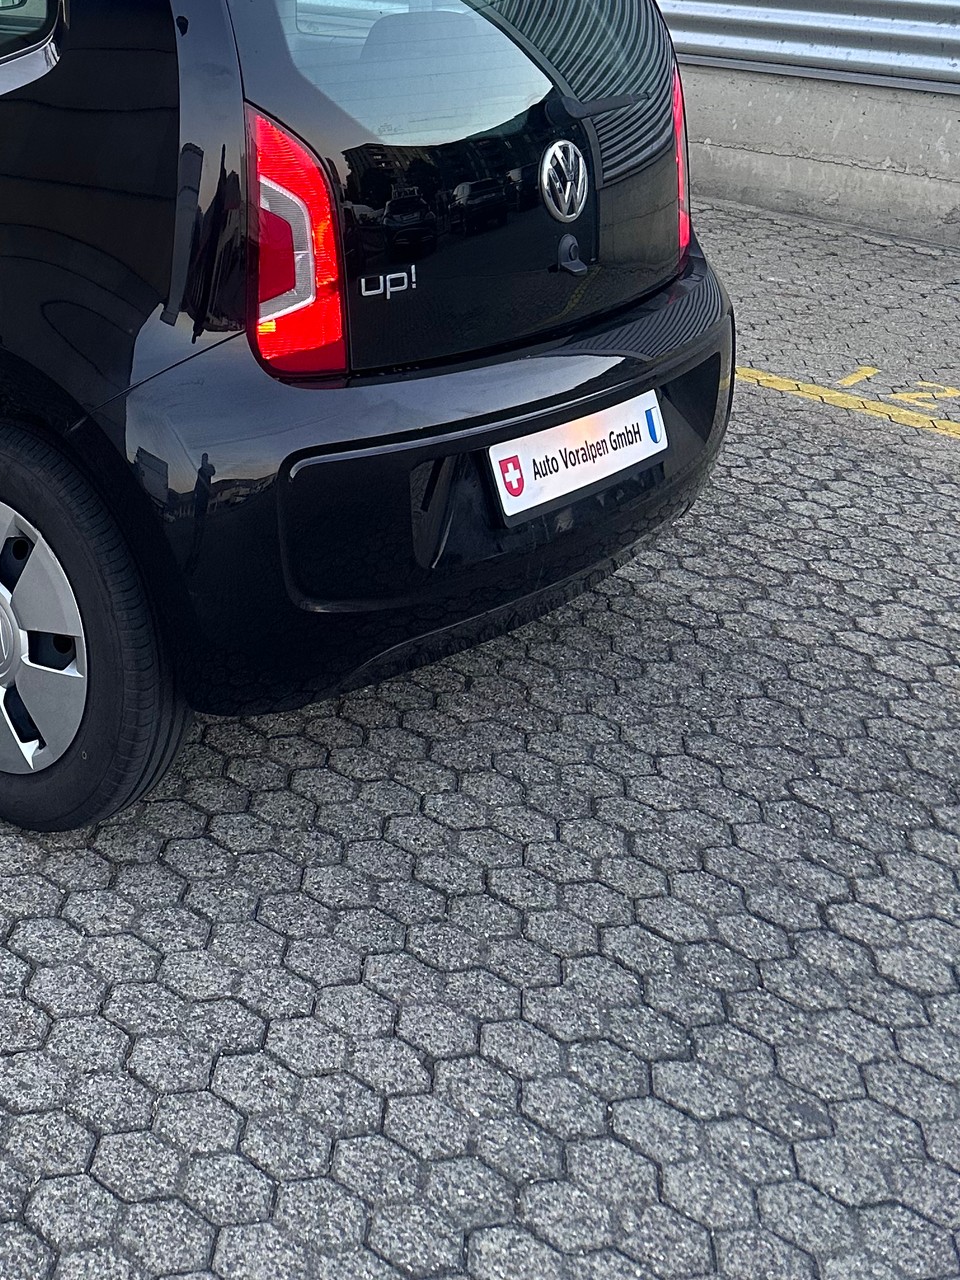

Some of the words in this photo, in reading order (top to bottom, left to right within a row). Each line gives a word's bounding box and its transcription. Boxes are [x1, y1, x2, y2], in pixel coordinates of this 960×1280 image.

[360, 264, 417, 300] up!
[531, 454, 559, 481] Auto
[559, 438, 609, 469] Voralpen
[609, 422, 642, 451] GmbH
